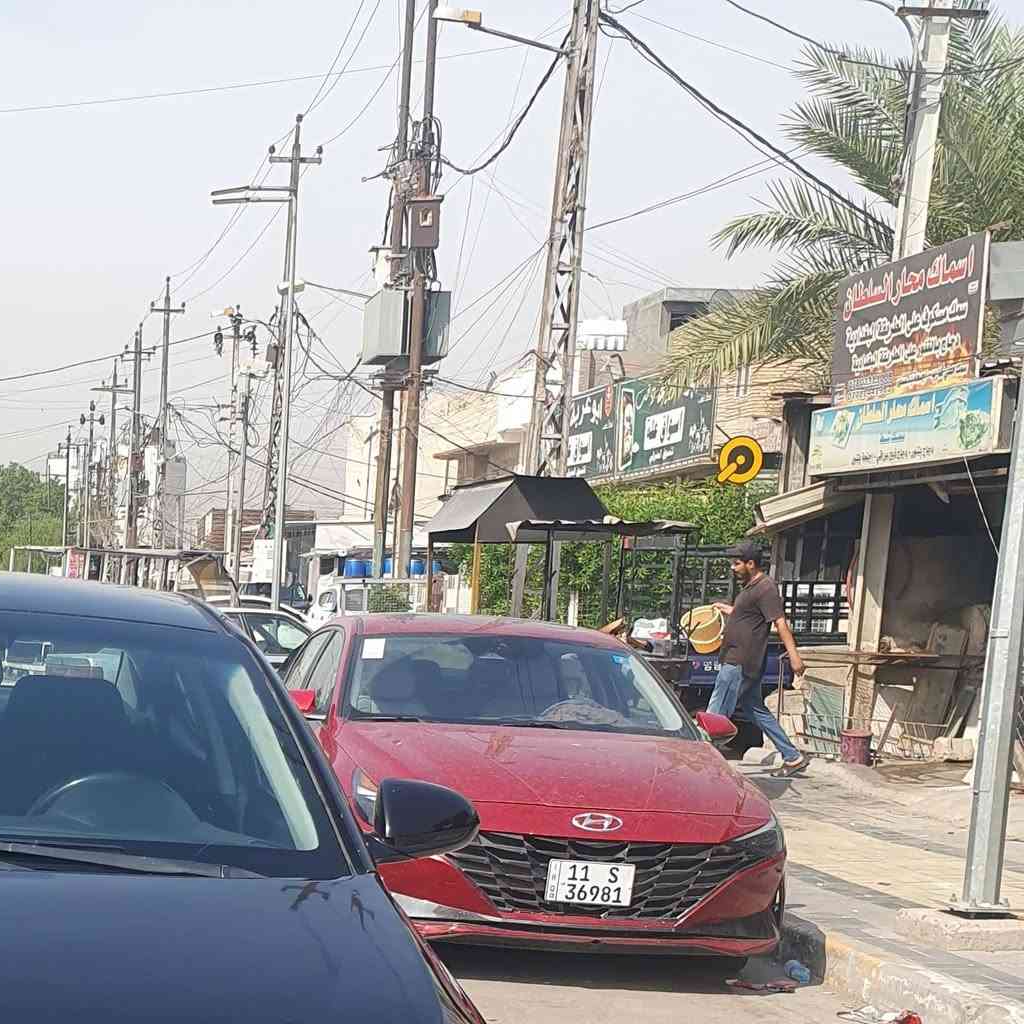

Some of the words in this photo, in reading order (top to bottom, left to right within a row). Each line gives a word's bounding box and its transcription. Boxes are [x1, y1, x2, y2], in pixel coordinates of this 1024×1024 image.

[567, 864, 590, 882] 11
[607, 866, 620, 884] S
[565, 883, 622, 904] 36981
